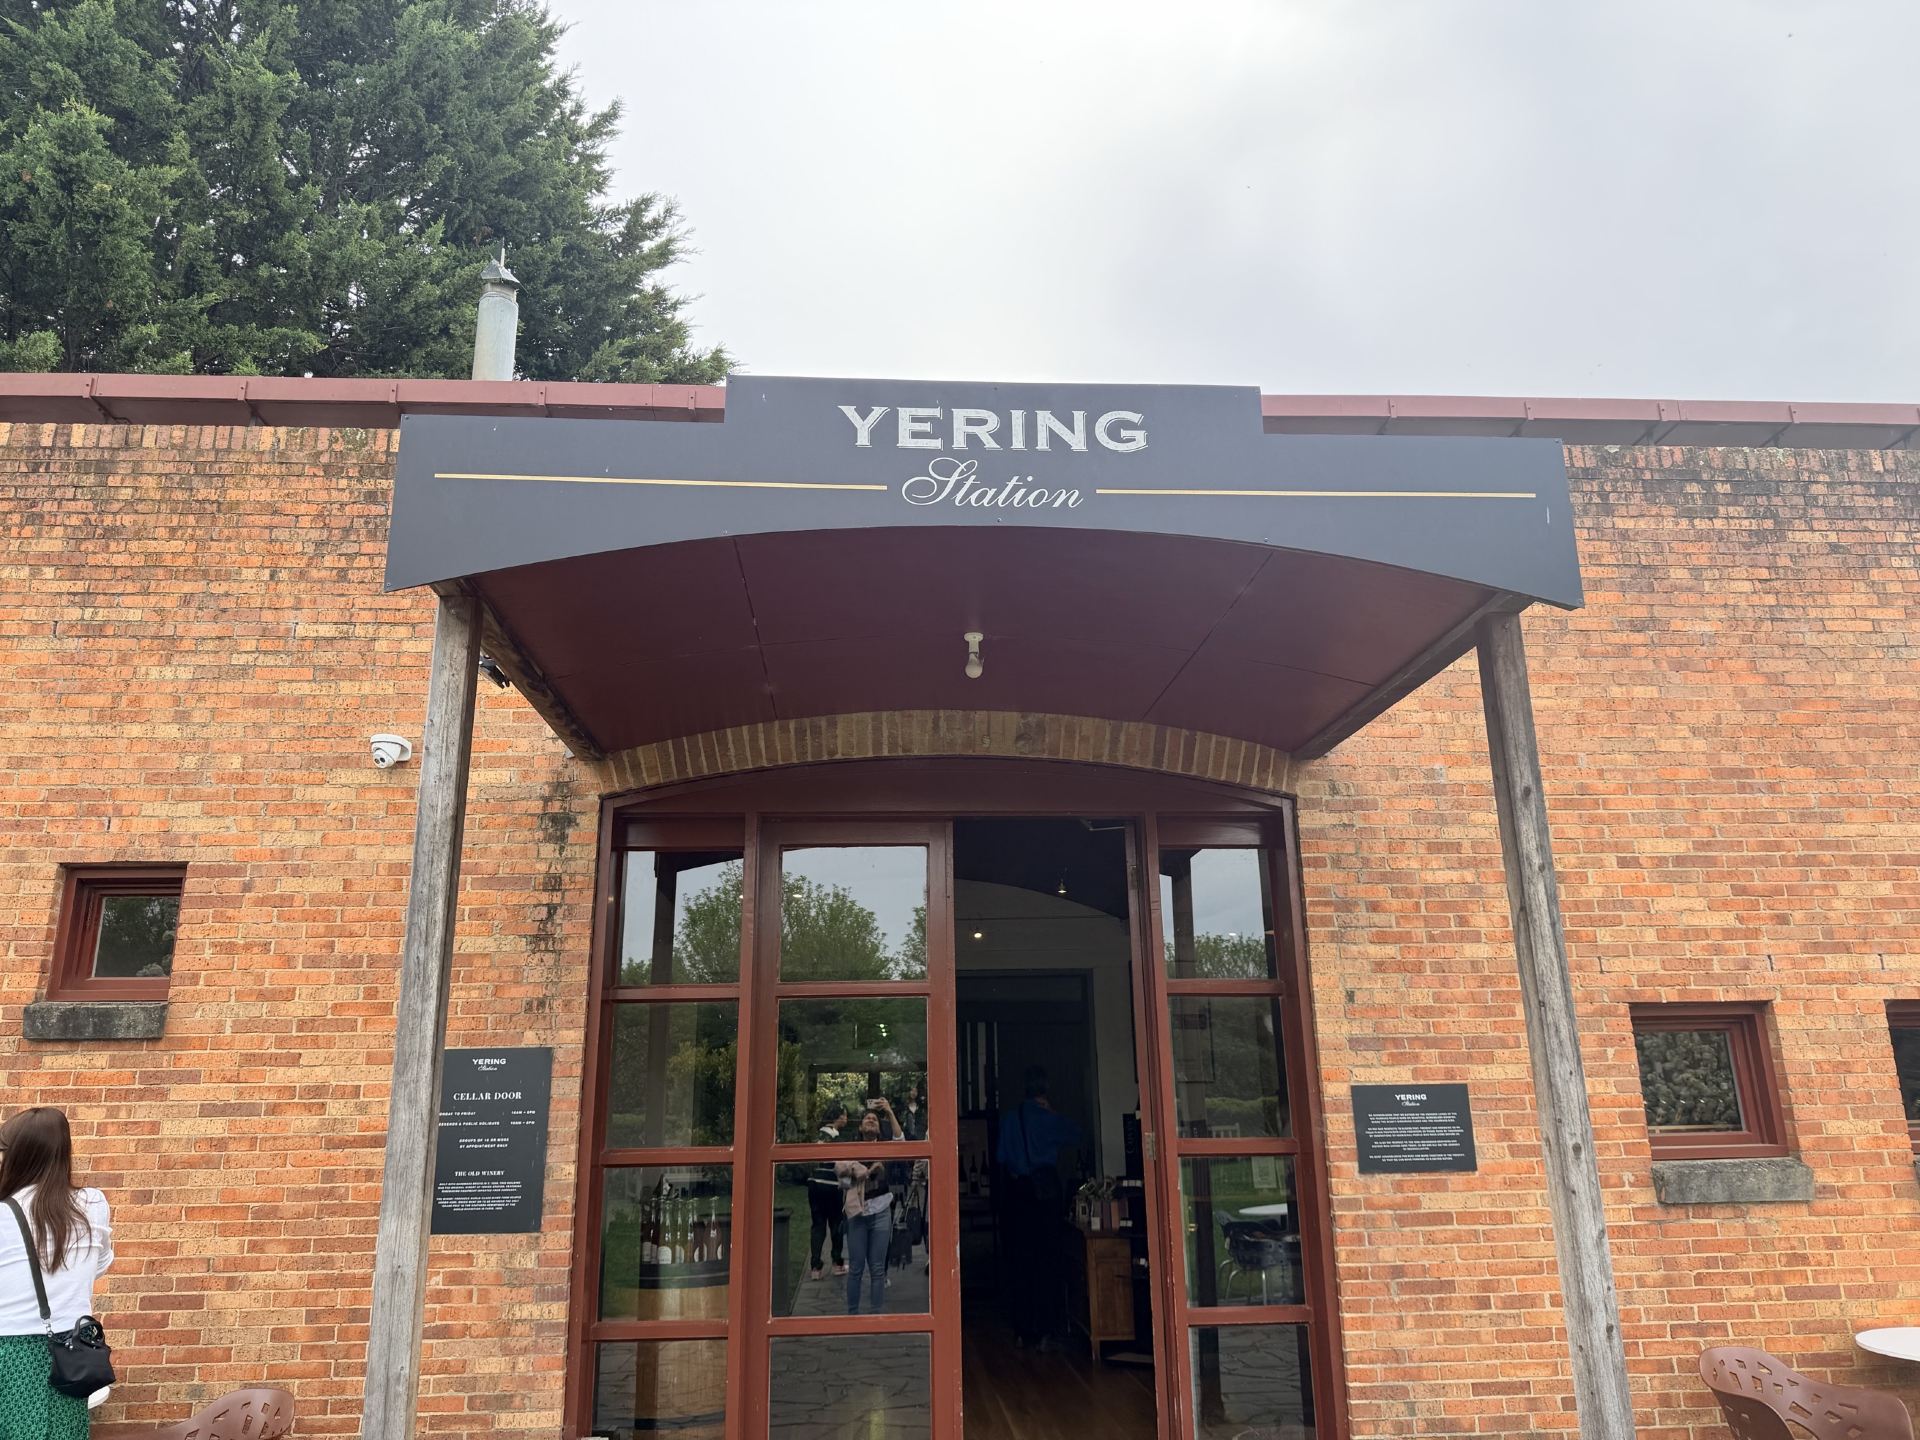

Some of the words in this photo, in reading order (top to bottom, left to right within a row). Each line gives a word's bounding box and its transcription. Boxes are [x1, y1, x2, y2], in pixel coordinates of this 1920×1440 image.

[837, 405, 1148, 453] YERING
[901, 457, 1083, 507] Station
[453, 1092, 491, 1100] CELLAR
[494, 1091, 522, 1100] DOOR
[1394, 1093, 1427, 1101] YERING
